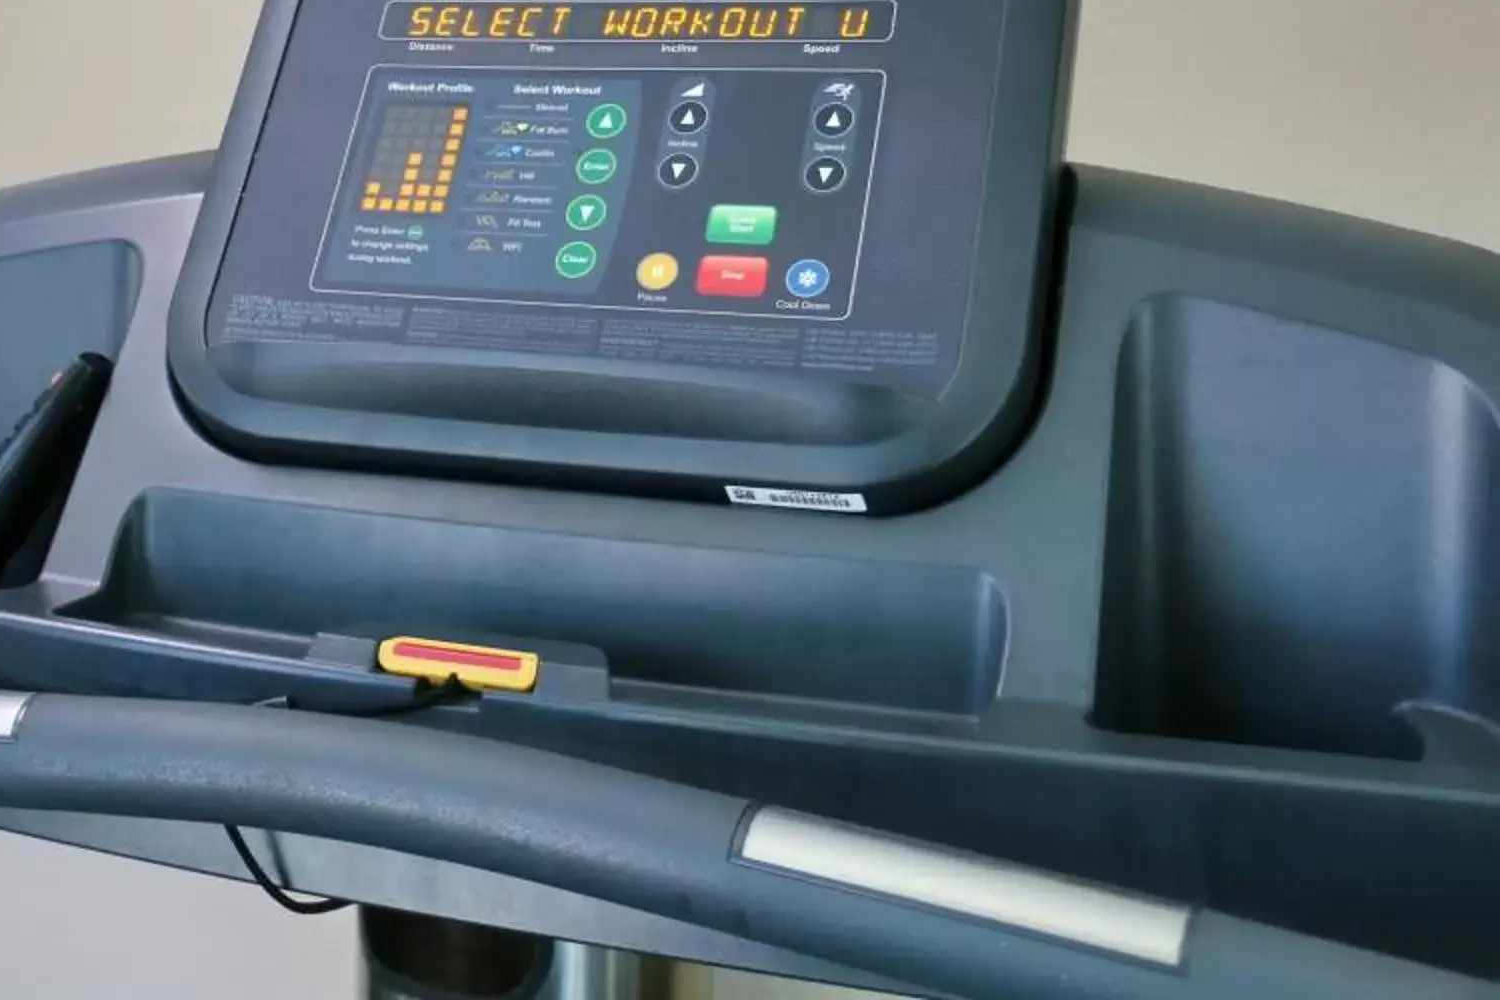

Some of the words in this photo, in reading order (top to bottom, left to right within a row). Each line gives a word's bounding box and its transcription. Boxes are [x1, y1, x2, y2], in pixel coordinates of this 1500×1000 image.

[408, 6, 572, 37] SELECT
[603, 6, 806, 38] WORKOUT
[408, 42, 454, 51] Distance
[529, 43, 555, 52] Time
[661, 43, 699, 53] Incline
[803, 43, 840, 55] Speed
[387, 81, 435, 93] Workout
[437, 82, 475, 93] Profile
[513, 83, 549, 95] Select
[551, 85, 603, 96] Workout
[637, 291, 668, 302] Pause
[775, 299, 799, 310] Cool
[801, 301, 832, 311] Down
